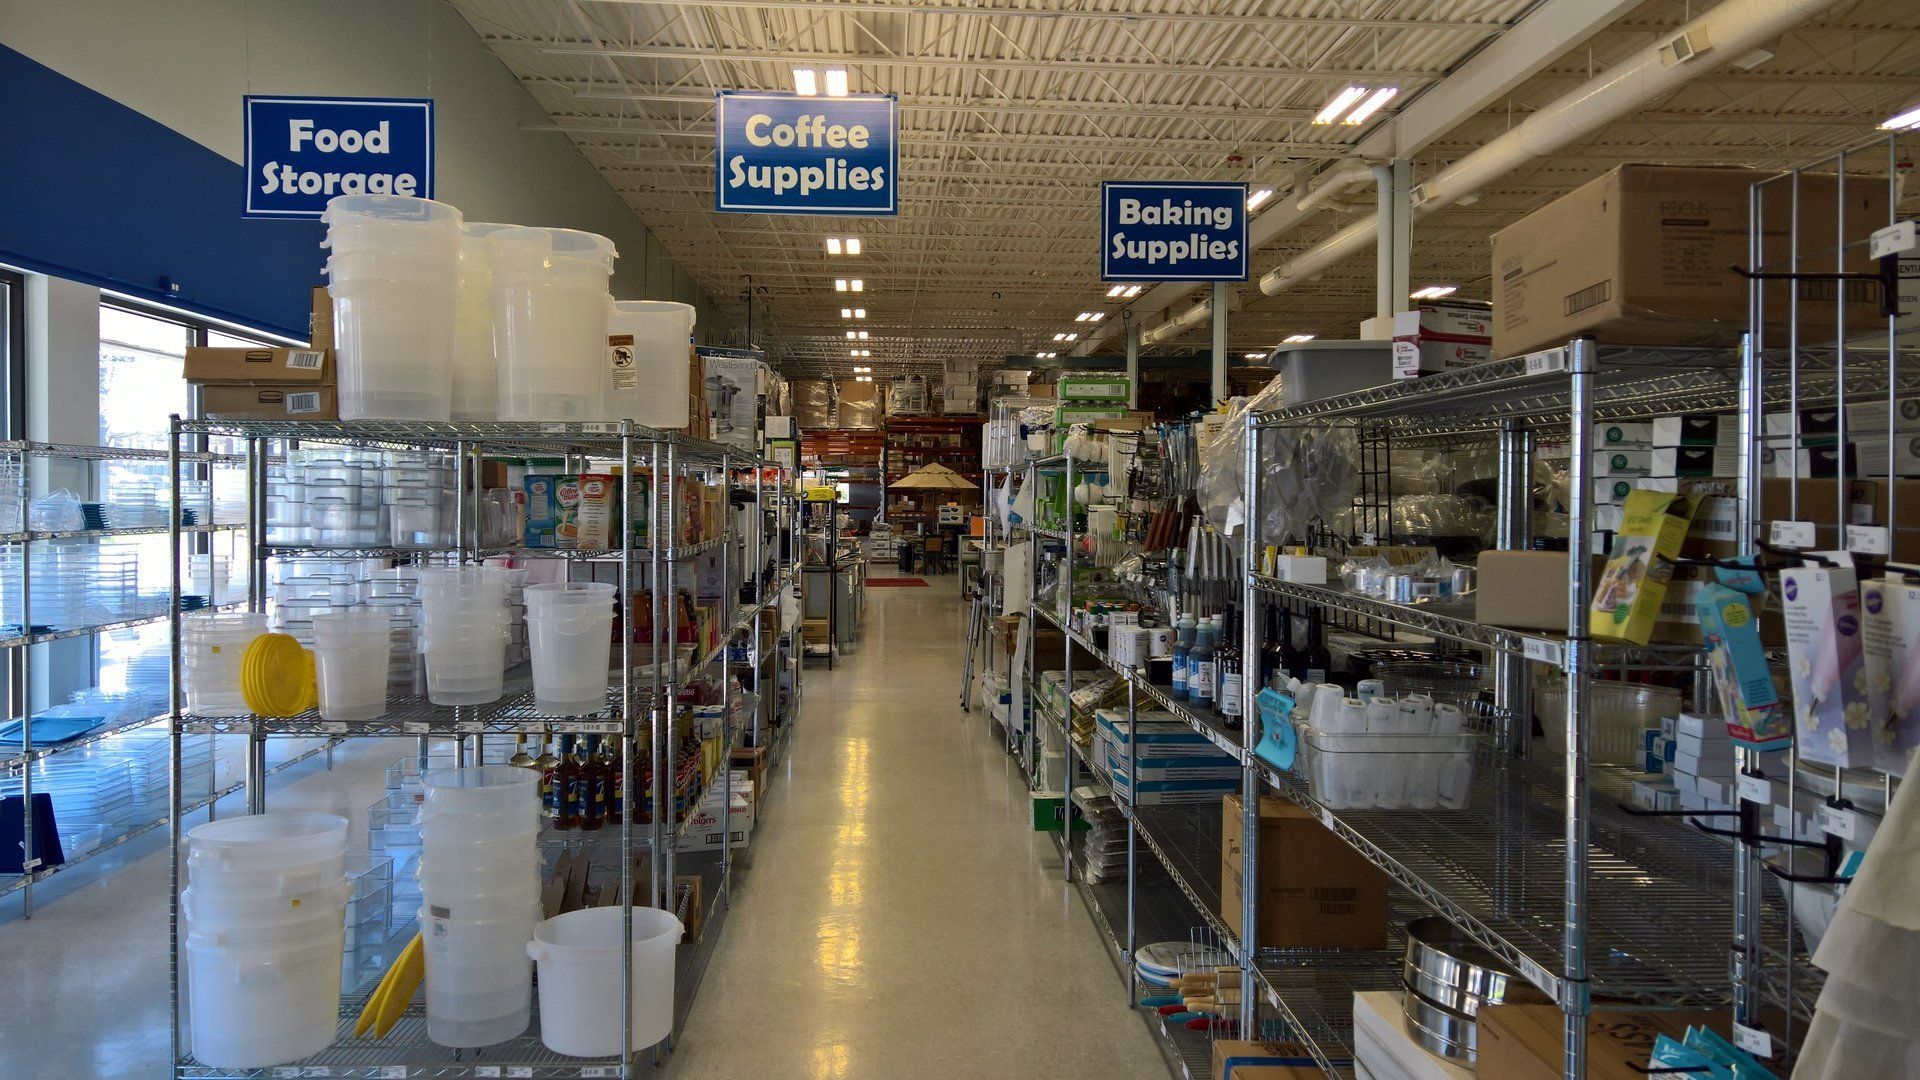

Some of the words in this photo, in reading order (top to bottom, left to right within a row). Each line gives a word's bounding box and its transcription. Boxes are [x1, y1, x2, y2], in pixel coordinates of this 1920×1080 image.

[289, 119, 390, 154] Food
[745, 114, 870, 148] Coffee
[728, 154, 885, 196] Supplies
[1119, 198, 1233, 230] Baking
[1661, 201, 1708, 215] FOCUS
[1112, 232, 1239, 265] Supplies
